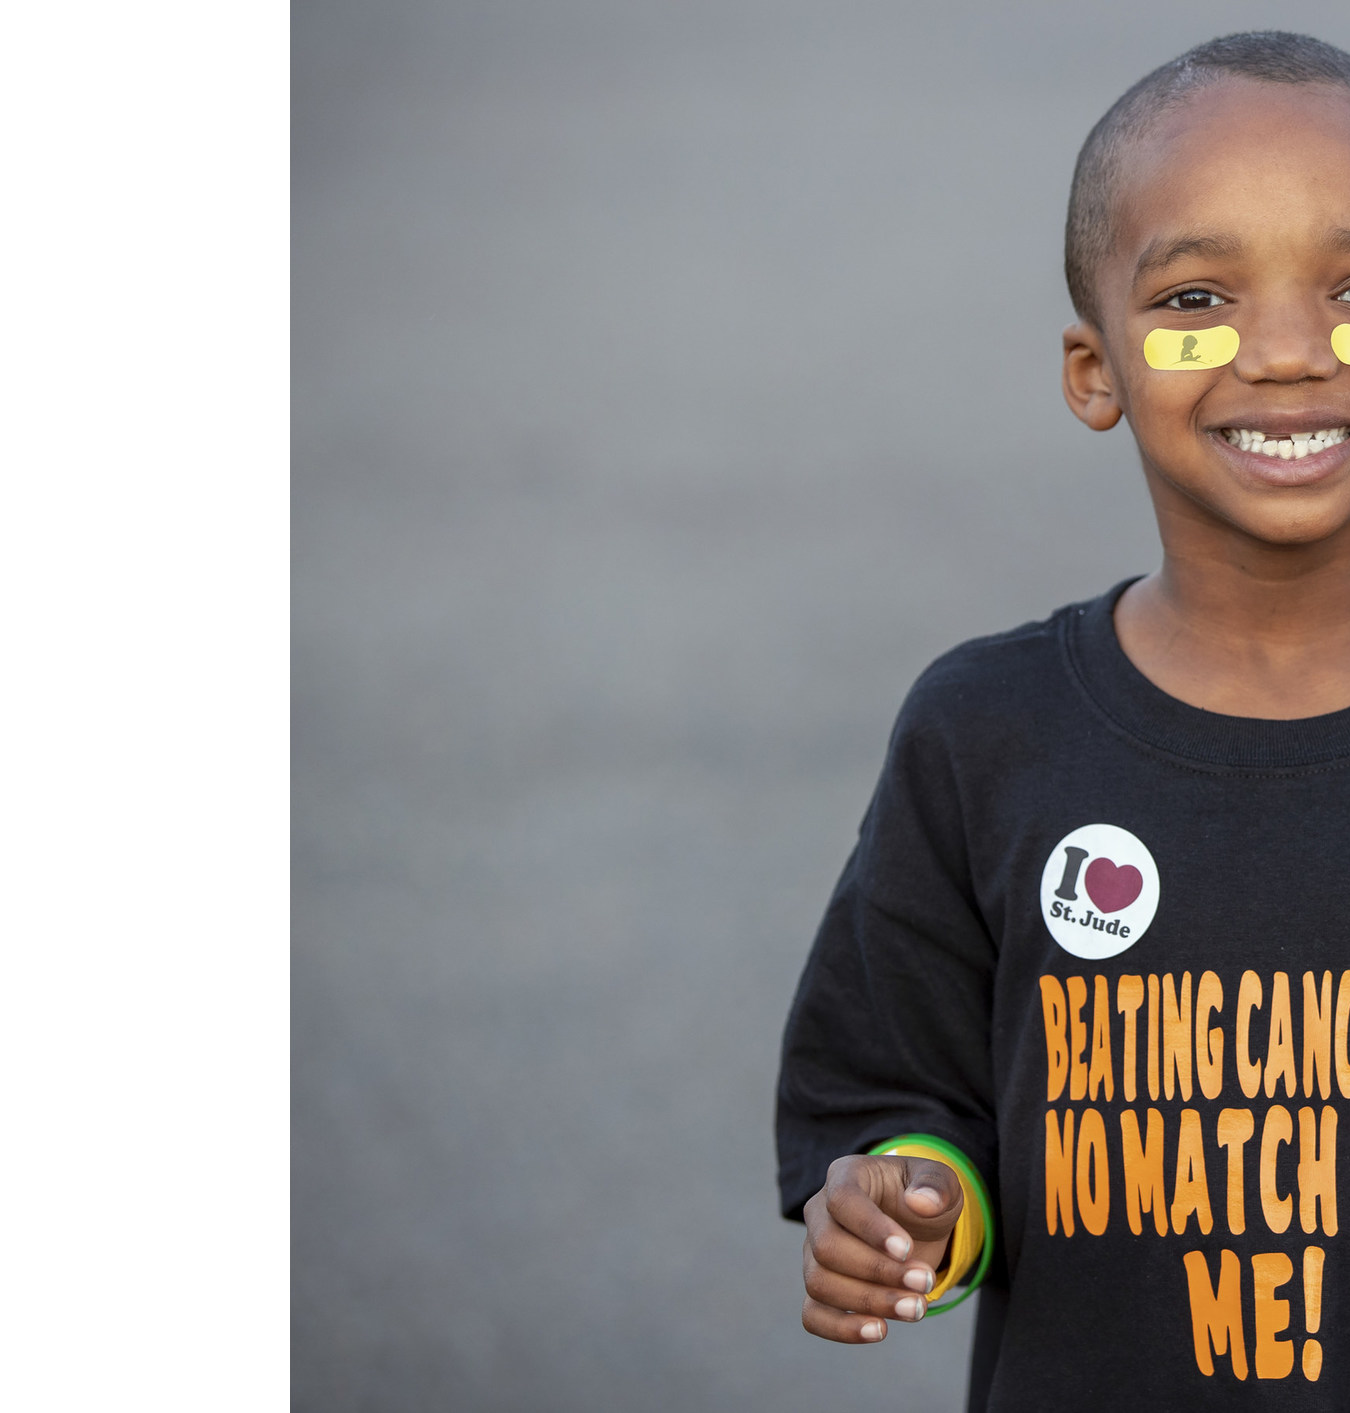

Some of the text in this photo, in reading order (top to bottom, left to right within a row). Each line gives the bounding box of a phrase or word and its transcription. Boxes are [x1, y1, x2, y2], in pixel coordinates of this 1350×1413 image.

[1050, 901, 1131, 938] St. Jude
[1054, 846, 1089, 901] I
[1039, 970, 1224, 1102] BEATING
[1045, 1108, 1109, 1237] NO
[1120, 1105, 1338, 1237] MATCH
[1183, 1246, 1325, 1381] ME!
